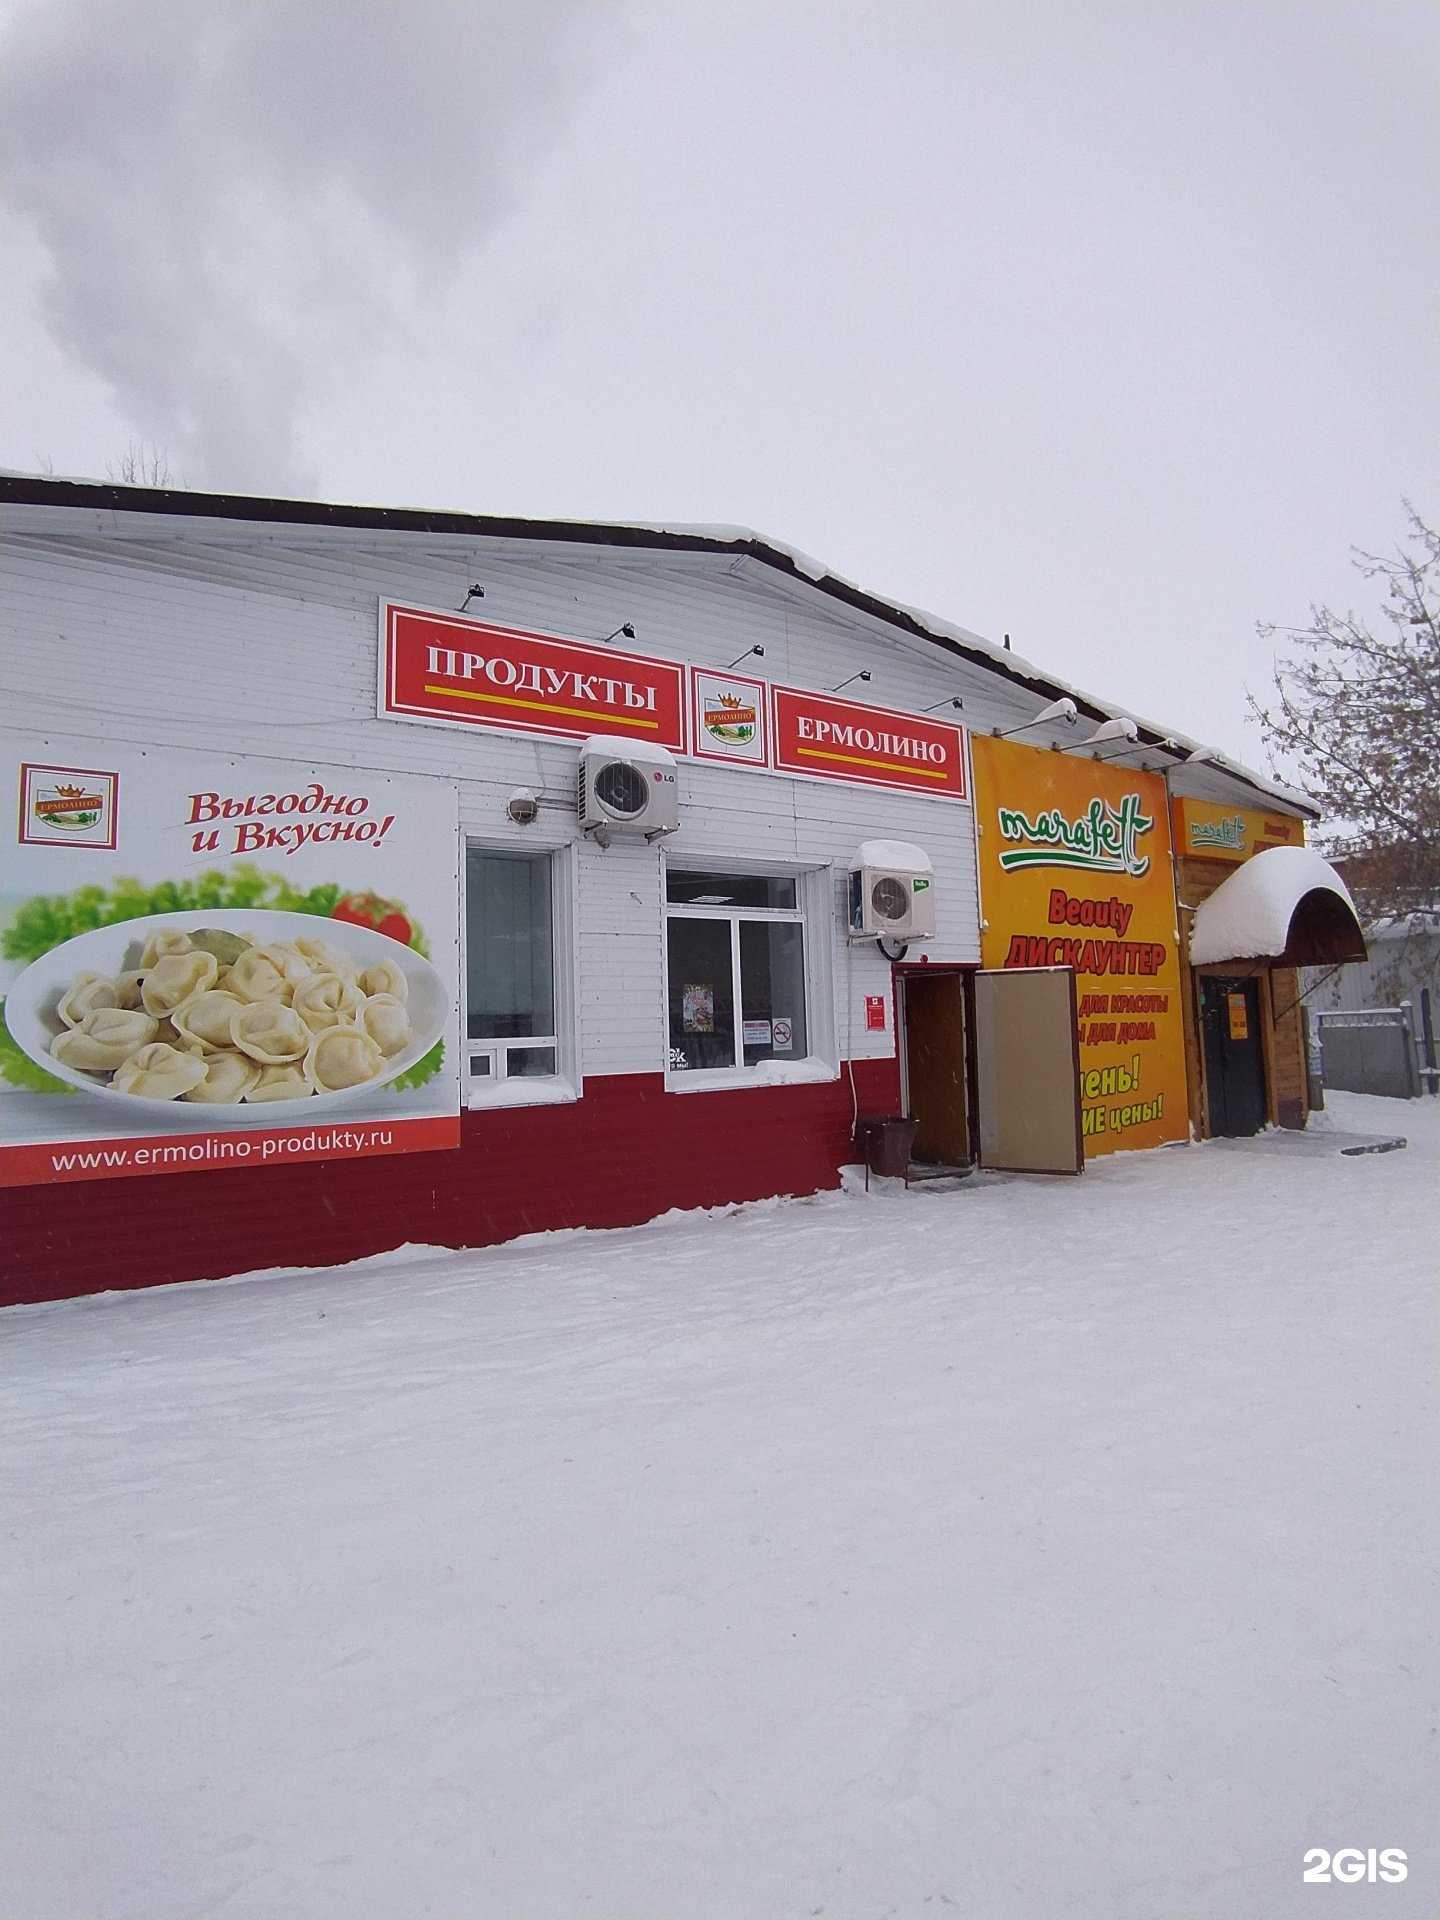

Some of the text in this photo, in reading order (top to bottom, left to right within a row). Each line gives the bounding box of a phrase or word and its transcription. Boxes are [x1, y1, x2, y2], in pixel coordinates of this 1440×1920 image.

[425, 645, 658, 712] ПРОДУКТЫ
[796, 715, 947, 764] ЕРМОЛИНО
[184, 783, 369, 826] Выгодно
[191, 815, 396, 856] и Вкусно!
[999, 793, 1153, 875] marafett
[1048, 888, 1133, 938] Beauty
[1004, 935, 1167, 976] ДИСКАУНТЕР
[1110, 994, 1169, 1014] КРАСОТЫ
[1117, 1021, 1157, 1045] ДОМА
[1109, 1092, 1165, 1135] цены!
[51, 1129, 393, 1172] www.ermolino-produkty.ru
